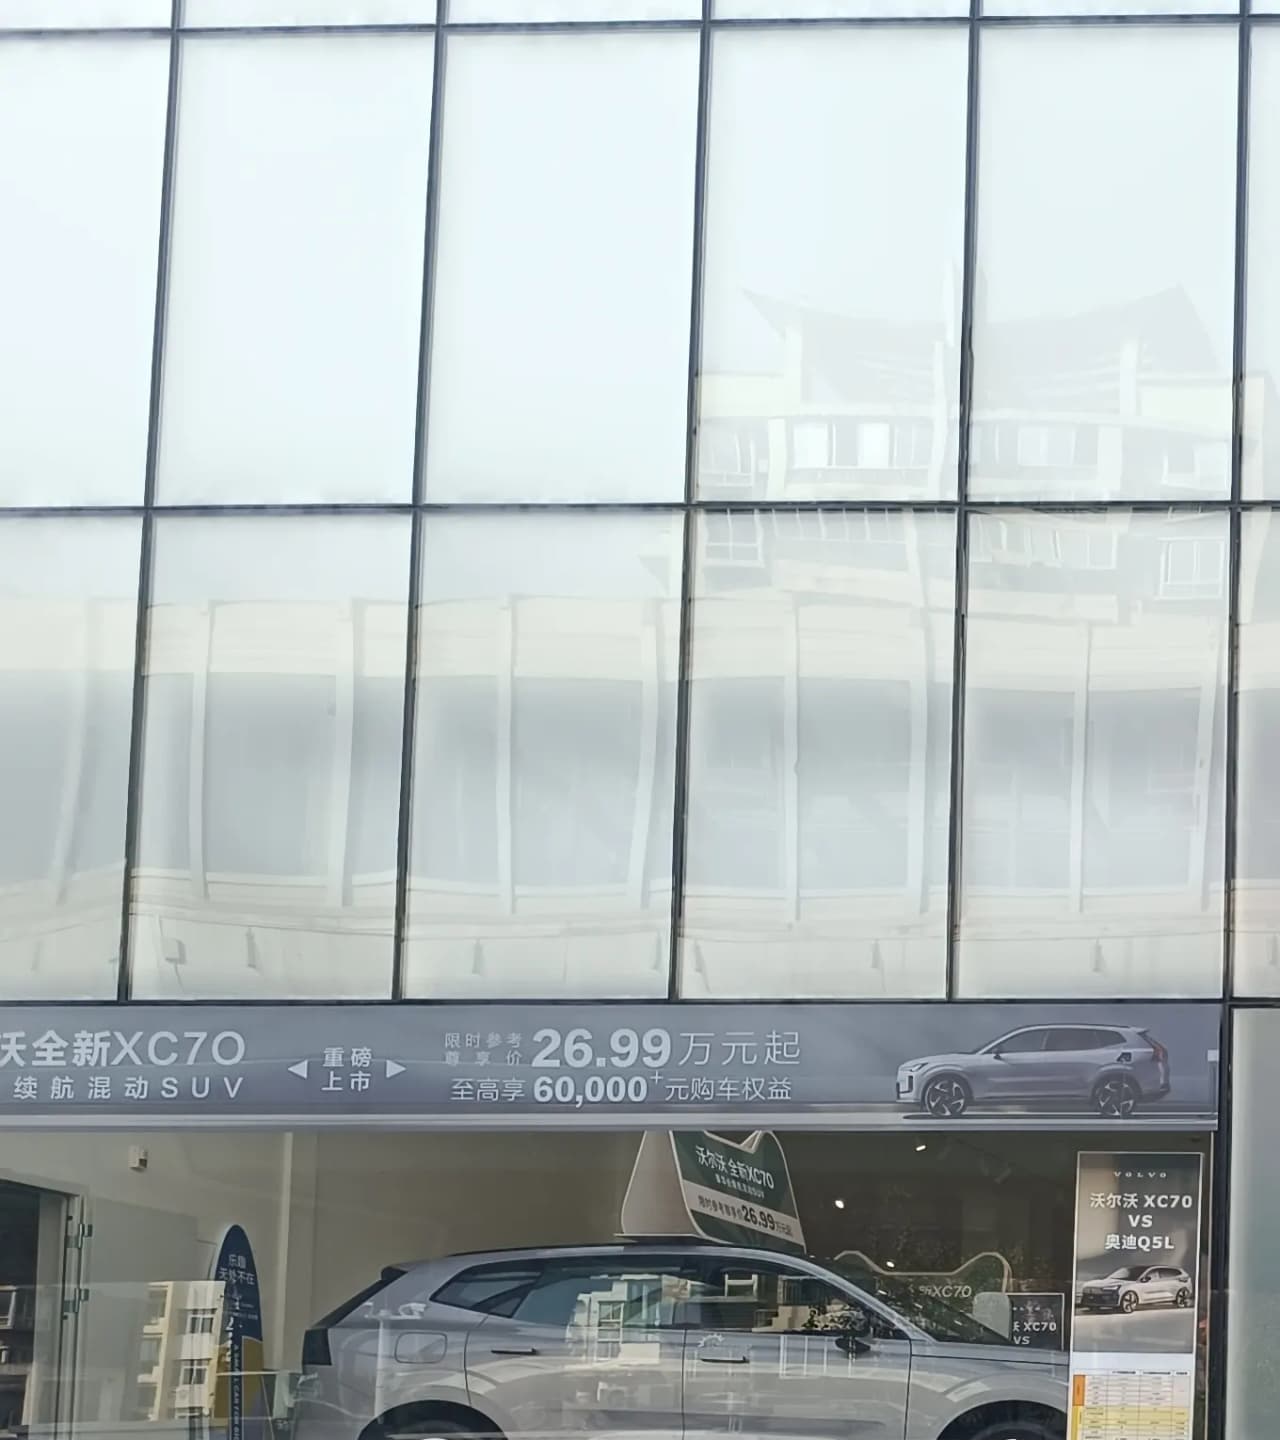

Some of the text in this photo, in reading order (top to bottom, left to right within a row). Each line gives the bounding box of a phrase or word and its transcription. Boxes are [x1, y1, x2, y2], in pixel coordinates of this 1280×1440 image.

[322, 1047, 372, 1067] 重磅
[321, 1070, 371, 1092] 上市
[1090, 1193, 1192, 1208] 沃尔沃 XC70
[741, 1205, 776, 1230] 26.99
[1128, 1215, 1153, 1227] VS
[1105, 1234, 1174, 1251] 奥迪Q5L
[1023, 1321, 1057, 1332] XC70
[1013, 1336, 1030, 1345] VS
